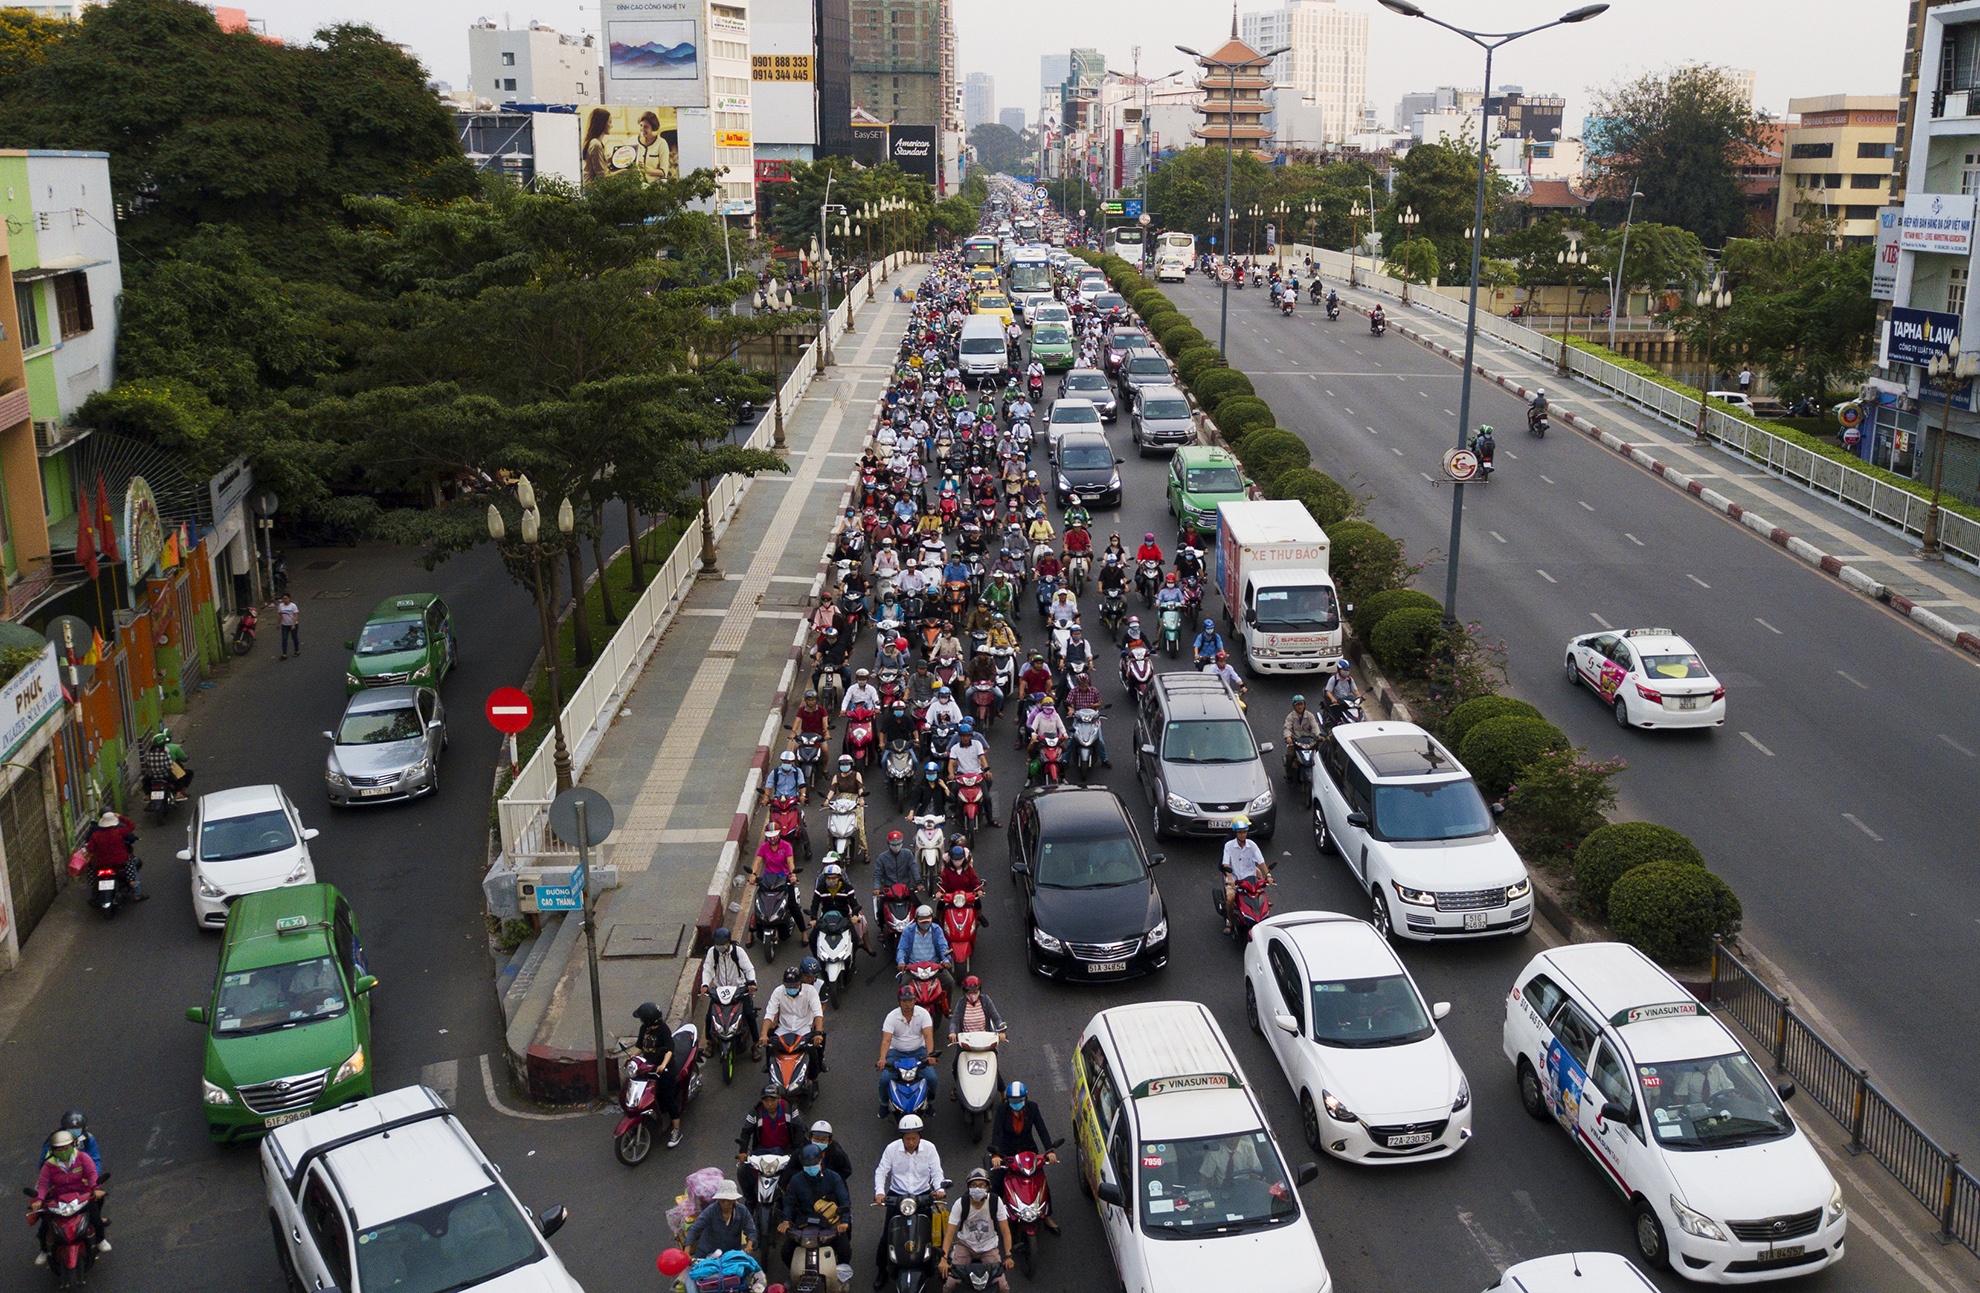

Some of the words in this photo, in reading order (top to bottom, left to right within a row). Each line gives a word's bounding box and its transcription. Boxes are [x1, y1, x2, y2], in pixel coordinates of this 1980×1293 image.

[752, 56, 772, 67] 0901
[775, 56, 790, 67] 888
[792, 56, 808, 67] 333
[753, 69, 773, 80] 0914
[775, 69, 790, 80] 344
[792, 69, 808, 80] 445
[854, 130, 884, 139] EasySET
[894, 137, 930, 147] American
[894, 146, 928, 156] Standard
[1894, 321, 1922, 340] TAPHA
[1929, 325, 1954, 345] LAW
[1251, 550, 1265, 561] XE
[1269, 549, 1294, 560] THƯ
[1295, 546, 1318, 560] BÁO
[15, 675, 43, 714] PHÚC
[541, 898, 553, 906] CAO
[279, 917, 304, 928] TAXI
